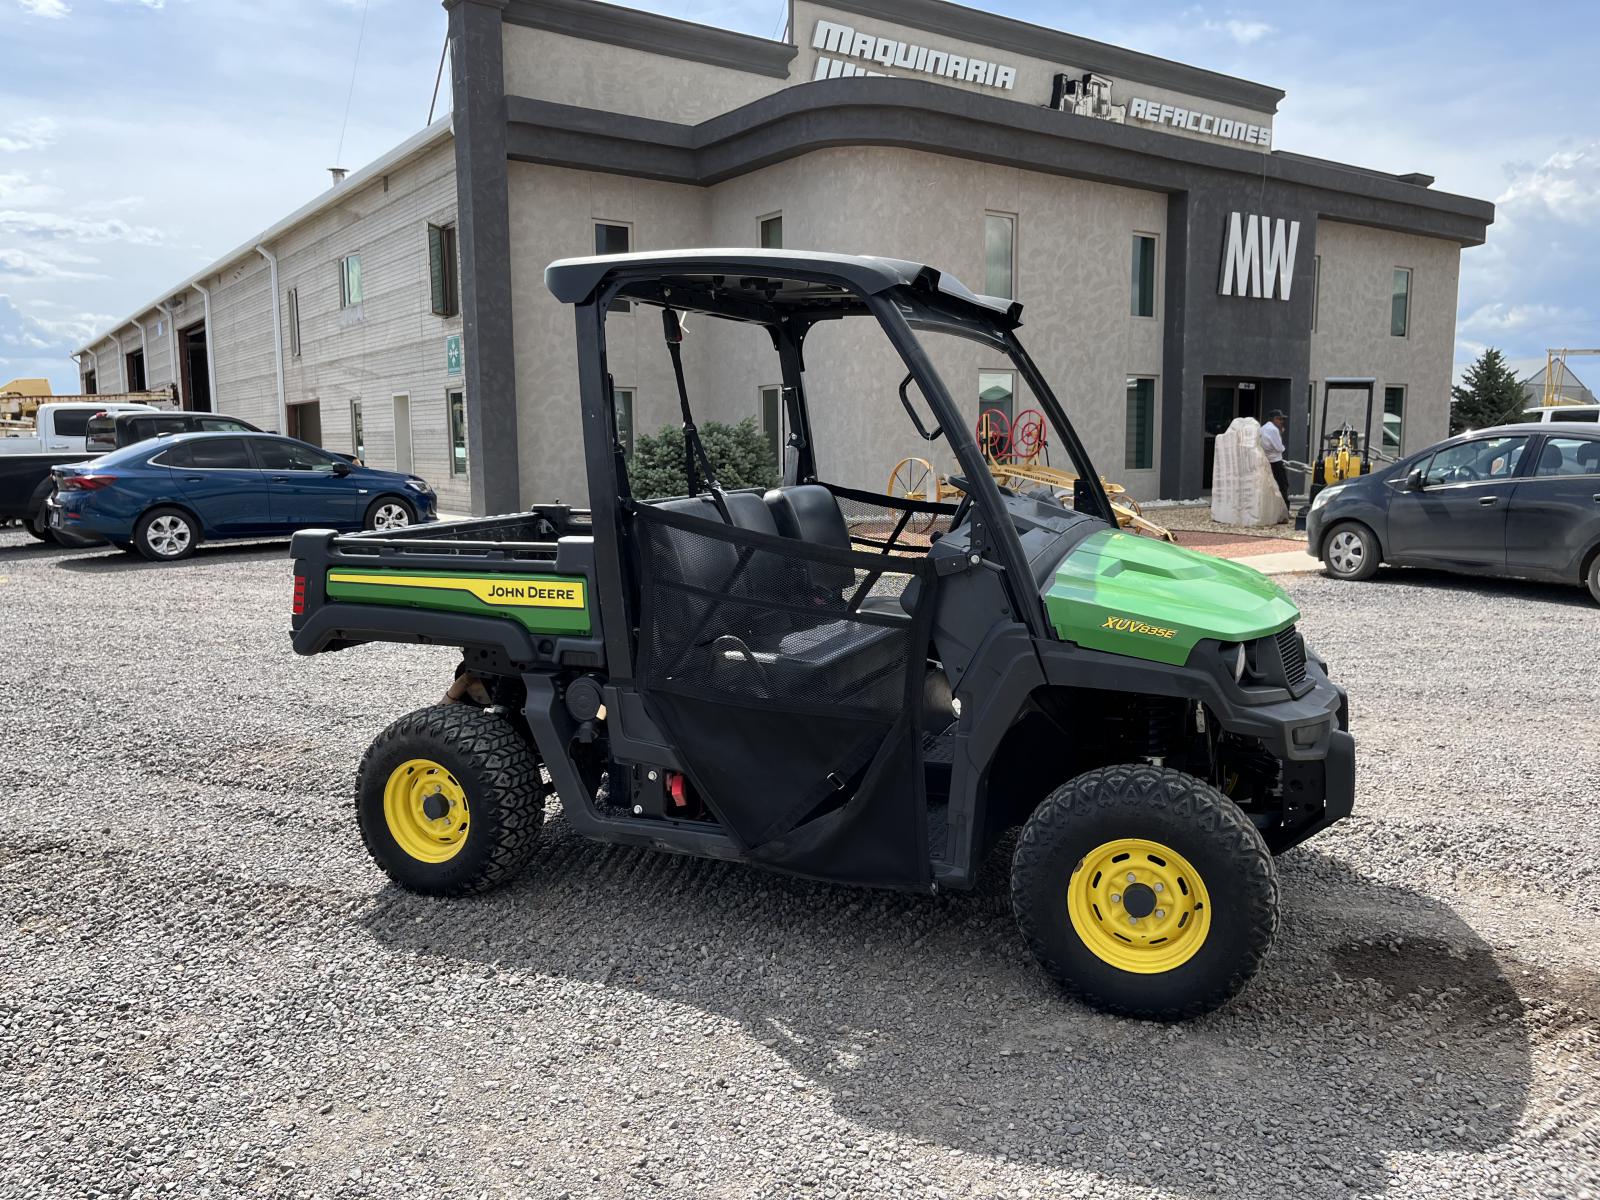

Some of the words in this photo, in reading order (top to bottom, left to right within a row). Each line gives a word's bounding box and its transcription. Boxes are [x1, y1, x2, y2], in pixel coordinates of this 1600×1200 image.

[812, 20, 1016, 90] MAQUINARIA
[1129, 97, 1272, 146] REFACCIONES
[1221, 211, 1300, 301] MW
[488, 585, 525, 598] JOHN
[527, 586, 575, 600] DEERE
[1101, 615, 1176, 639] XUV835E
